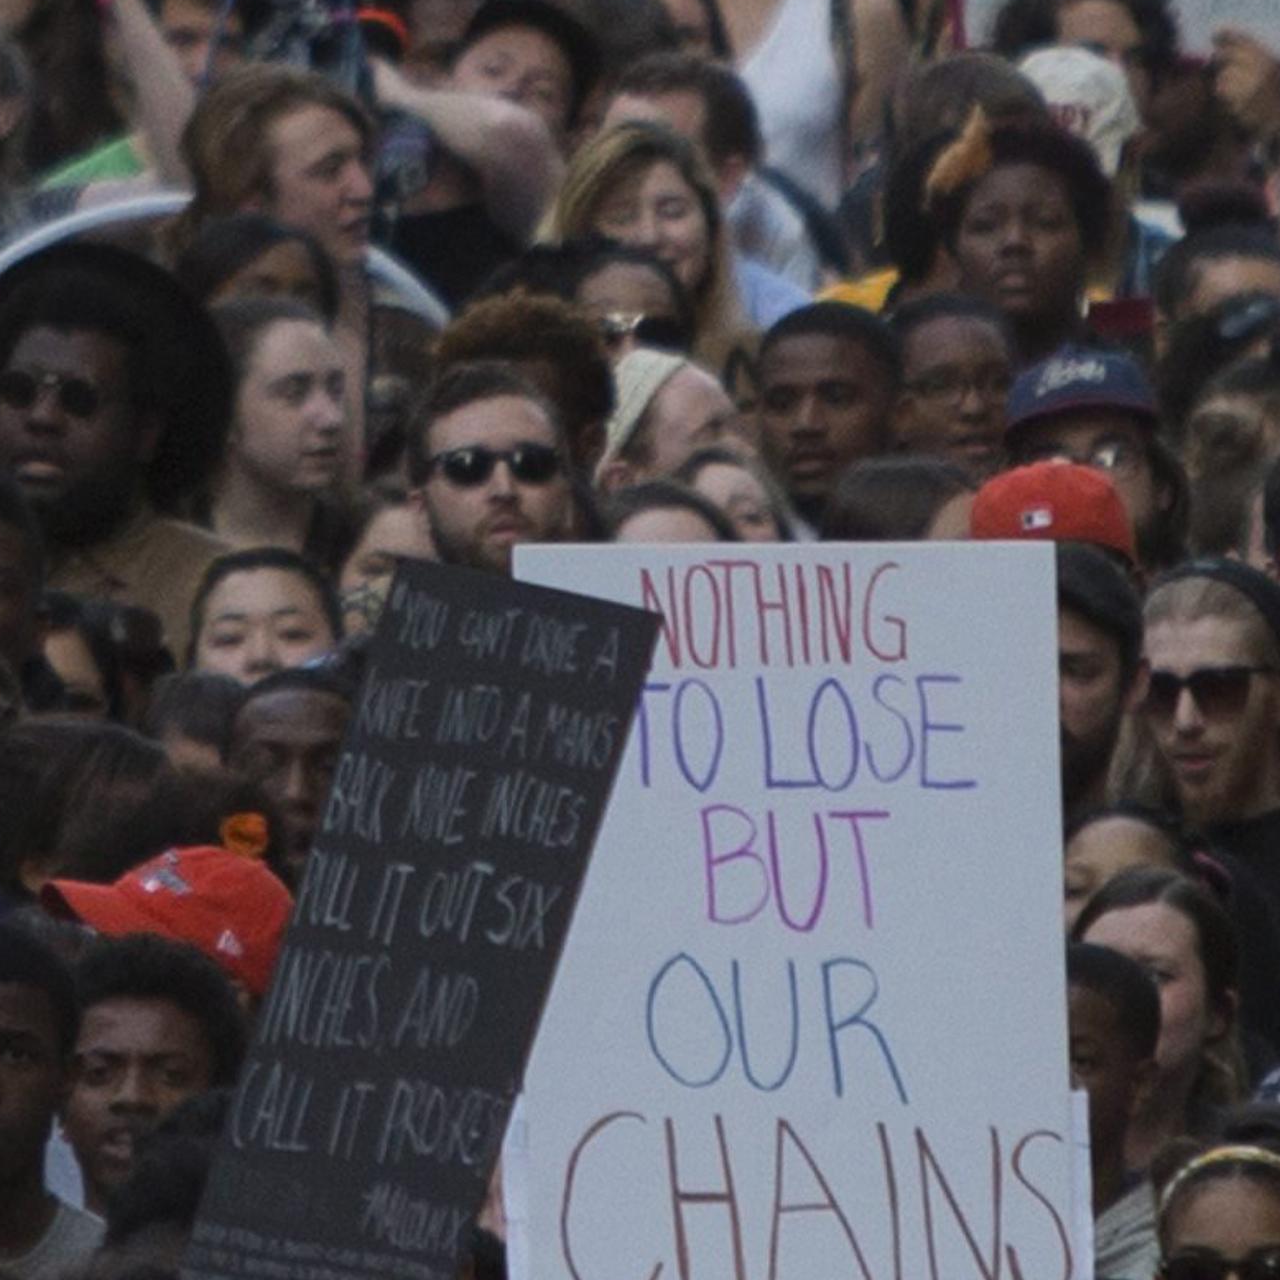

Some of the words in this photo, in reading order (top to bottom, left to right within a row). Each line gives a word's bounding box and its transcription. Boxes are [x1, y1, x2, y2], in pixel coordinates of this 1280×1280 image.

[587, 625, 621, 682] A
[638, 560, 909, 672] NOTHING
[500, 690, 533, 760] A
[634, 677, 724, 794] TO
[756, 675, 977, 792] LOSE
[366, 862, 416, 947] IT
[417, 860, 496, 944] OUT
[483, 875, 564, 951] SIX
[701, 804, 891, 934] BUT
[392, 965, 480, 1048] AND
[646, 952, 909, 1106] OUR
[230, 1058, 317, 1153] CALL
[327, 1081, 377, 1163] IT
